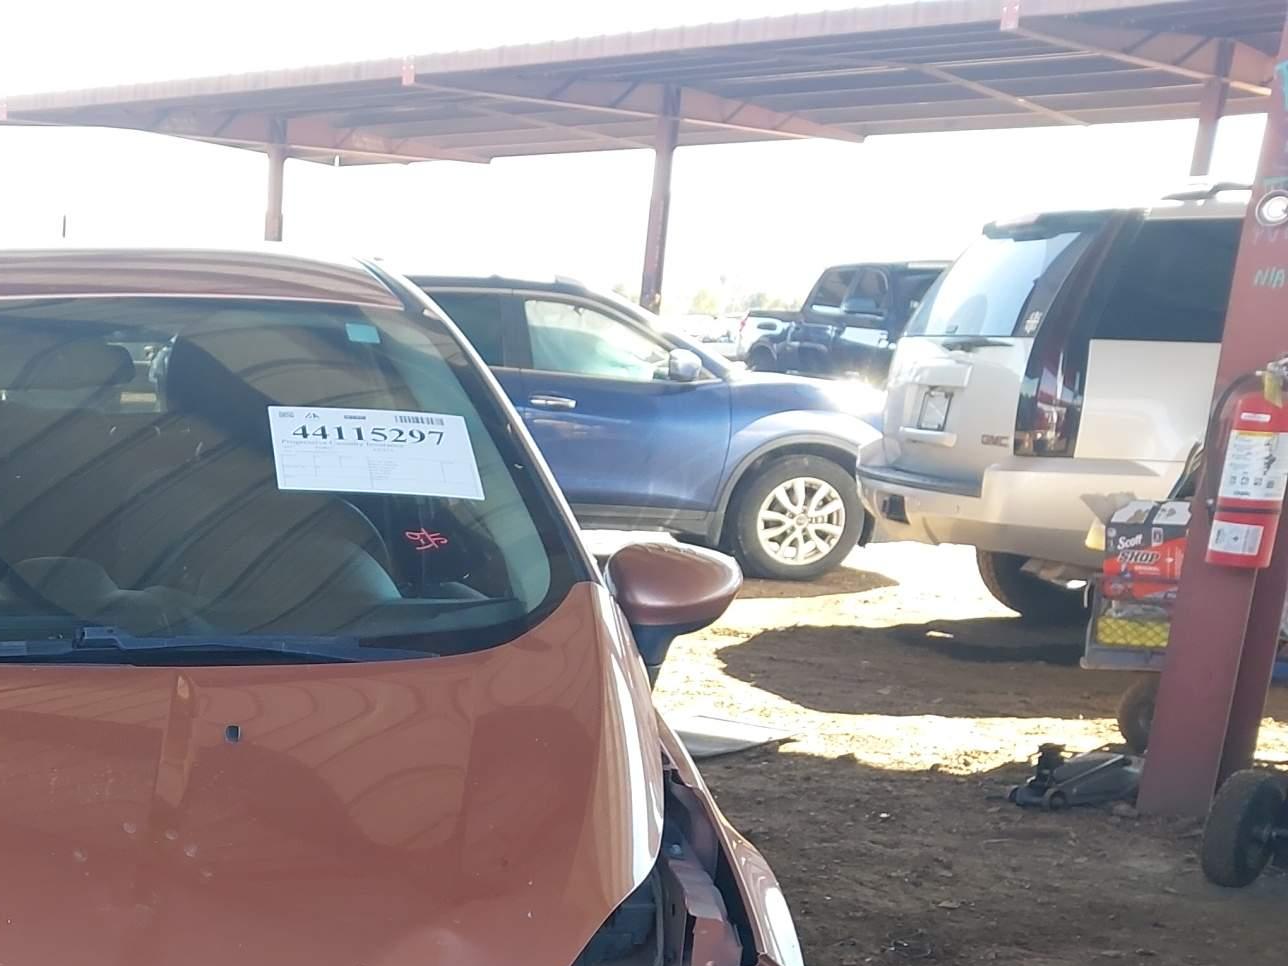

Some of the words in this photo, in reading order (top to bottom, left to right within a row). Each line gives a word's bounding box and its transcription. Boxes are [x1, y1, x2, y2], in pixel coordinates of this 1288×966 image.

[292, 424, 444, 446] 44115297
[981, 434, 1010, 448] GMC
[1117, 533, 1143, 550] Scott
[1117, 550, 1160, 564] SHOP
